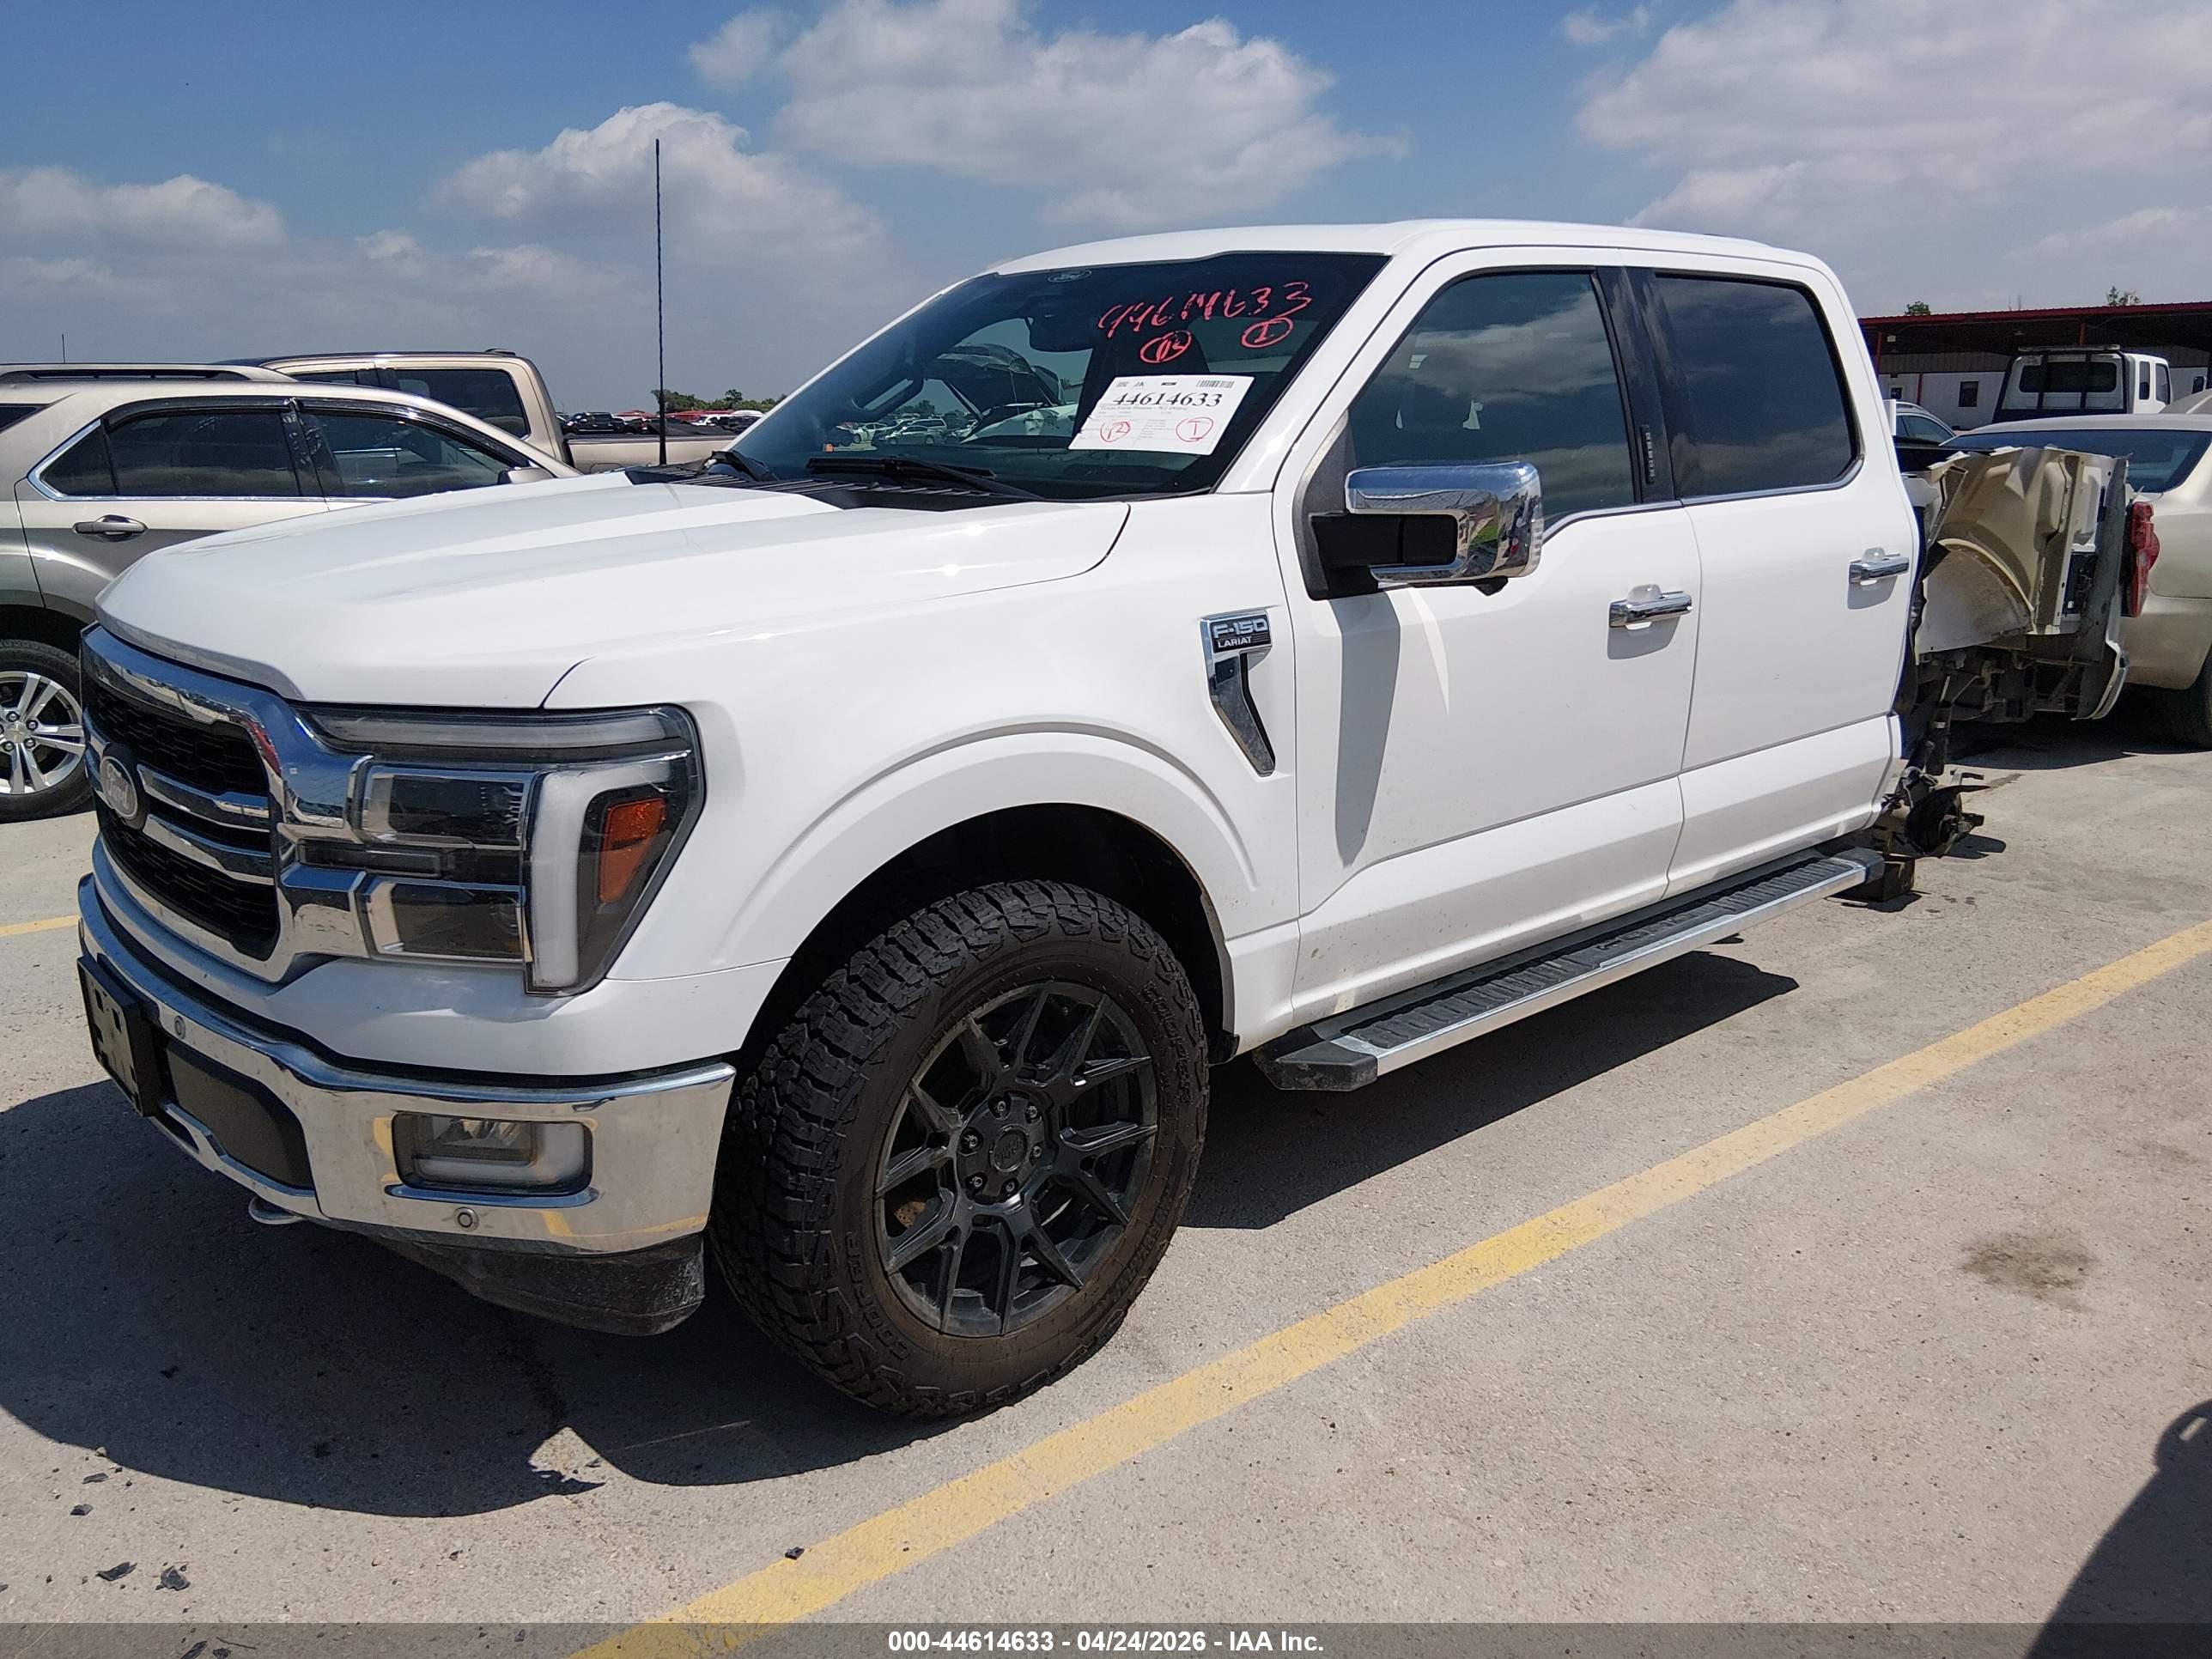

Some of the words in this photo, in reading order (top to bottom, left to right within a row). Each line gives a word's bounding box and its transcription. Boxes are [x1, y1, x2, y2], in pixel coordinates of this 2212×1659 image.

[1113, 392, 1224, 407] 44614633
[1212, 618, 1269, 639] F-150
[1217, 635, 1253, 648] LARIAT
[105, 760, 131, 810] Ford
[844, 1231, 911, 1361] COOPER
